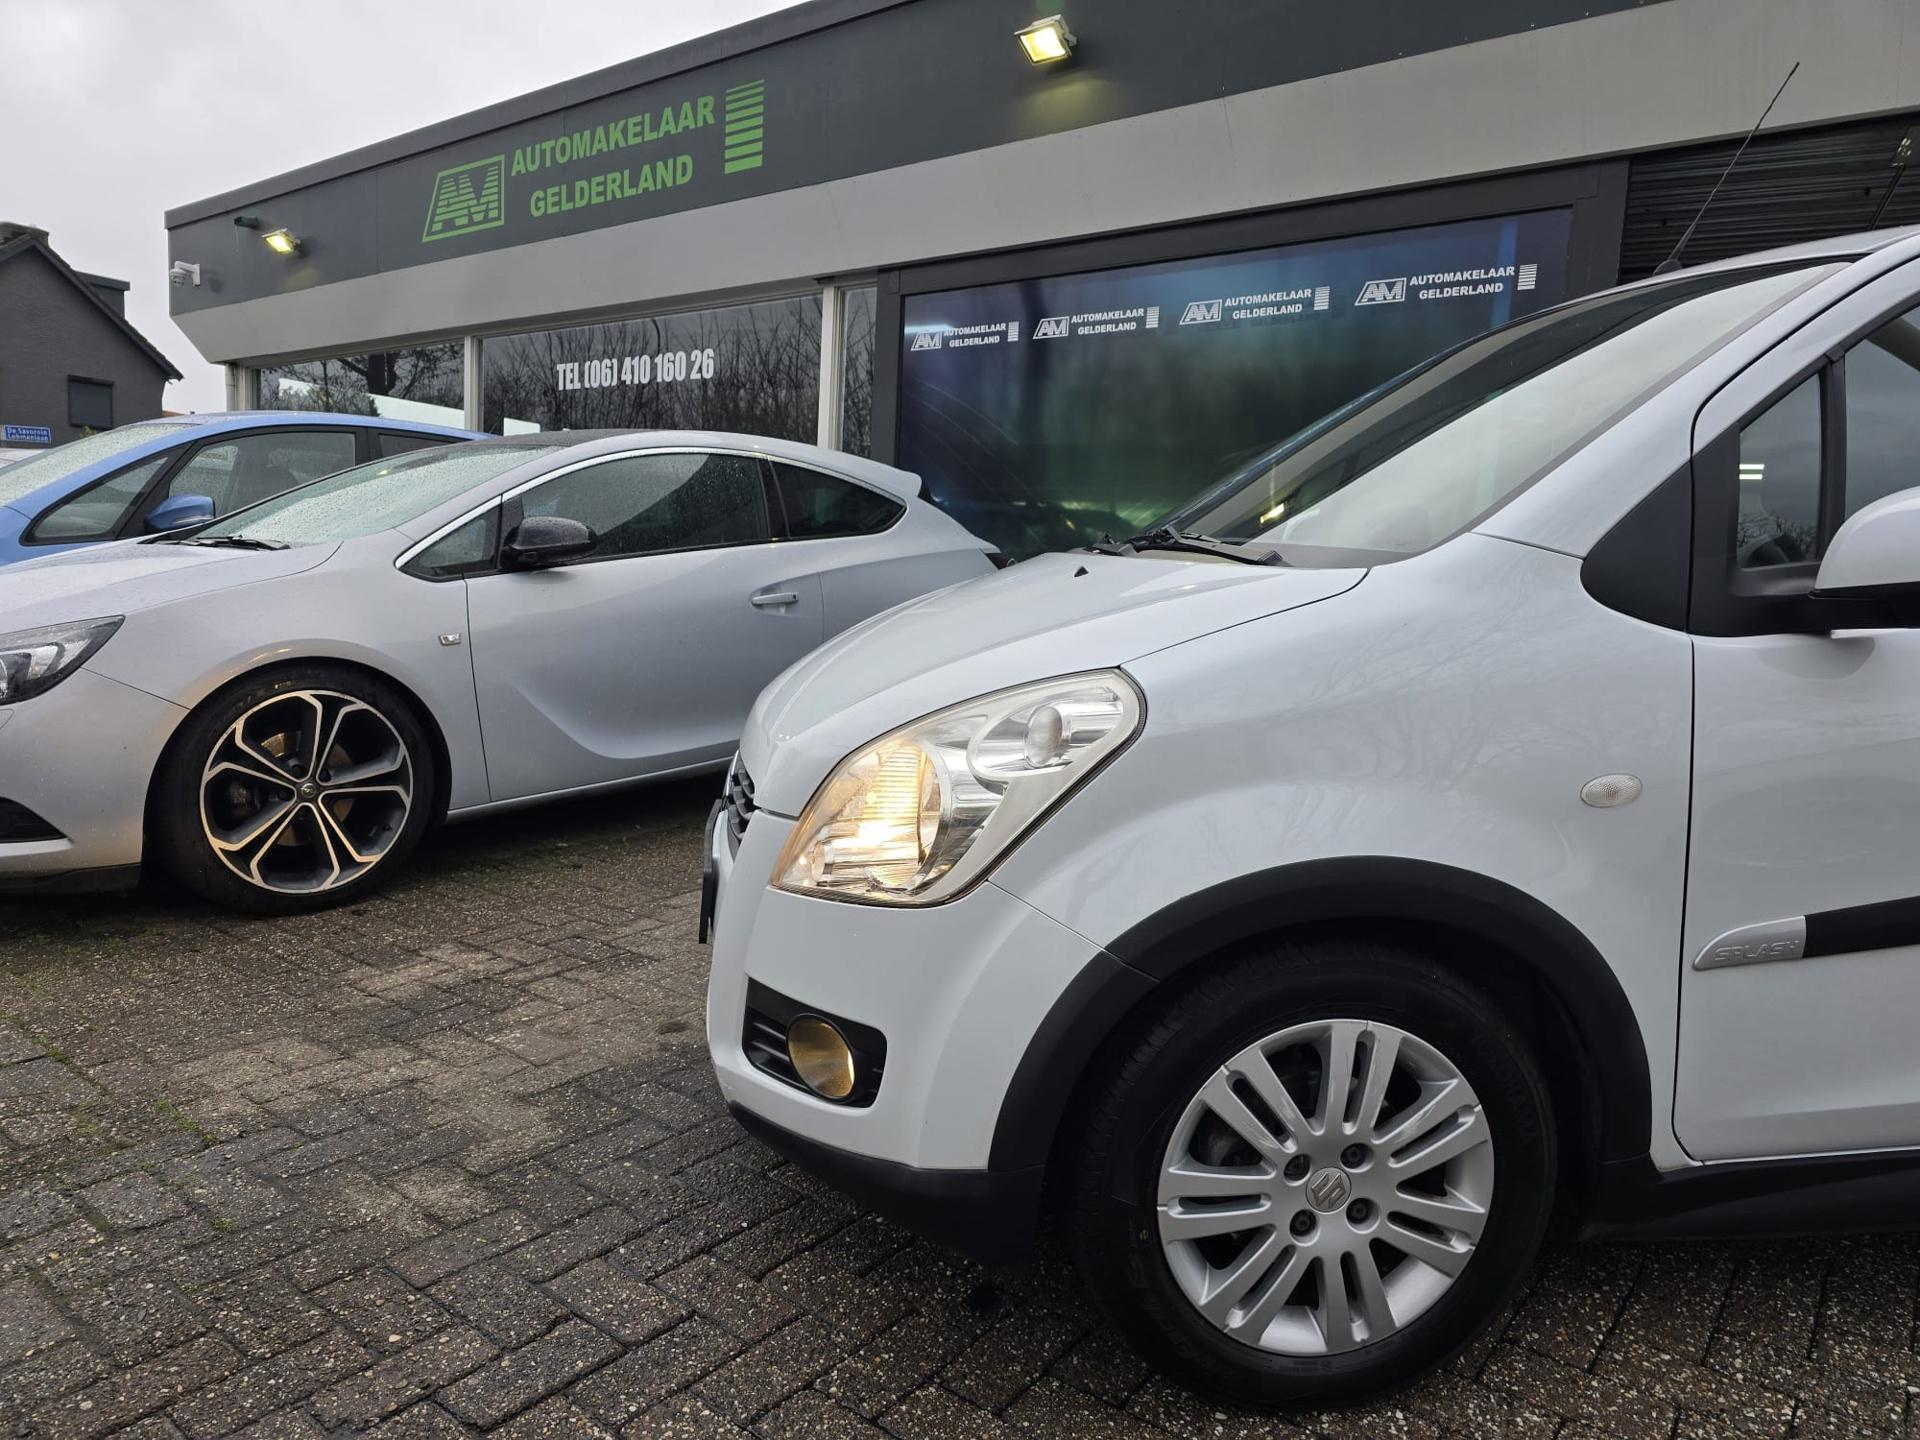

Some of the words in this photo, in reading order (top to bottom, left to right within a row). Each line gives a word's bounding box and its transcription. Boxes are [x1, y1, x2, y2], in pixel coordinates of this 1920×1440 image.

[511, 95, 715, 176] AUTOMAKELAAR
[530, 154, 693, 217] GELDERLAND
[431, 165, 499, 232] AM
[1410, 266, 1515, 286] AUTOMAKELAAR
[1225, 288, 1312, 307] AUTOMAKELAAR
[1361, 280, 1402, 302] AM
[1419, 283, 1504, 300] GELDERLAND
[1071, 308, 1144, 324] AUTOMAKELAAR
[1184, 302, 1218, 322] AM
[1232, 304, 1303, 320] GELDERLAND
[943, 322, 1006, 337] AUTOMAKELAAR
[1038, 320, 1066, 337] AM
[1078, 321, 1137, 335] GELDERLAND
[915, 333, 940, 348] AM
[949, 335, 1000, 348] GELDERLAND
[556, 362, 581, 391] TEL
[584, 358, 618, 388] (06)
[621, 355, 650, 385] 410
[654, 351, 686, 383] 160
[690, 348, 714, 380] 26
